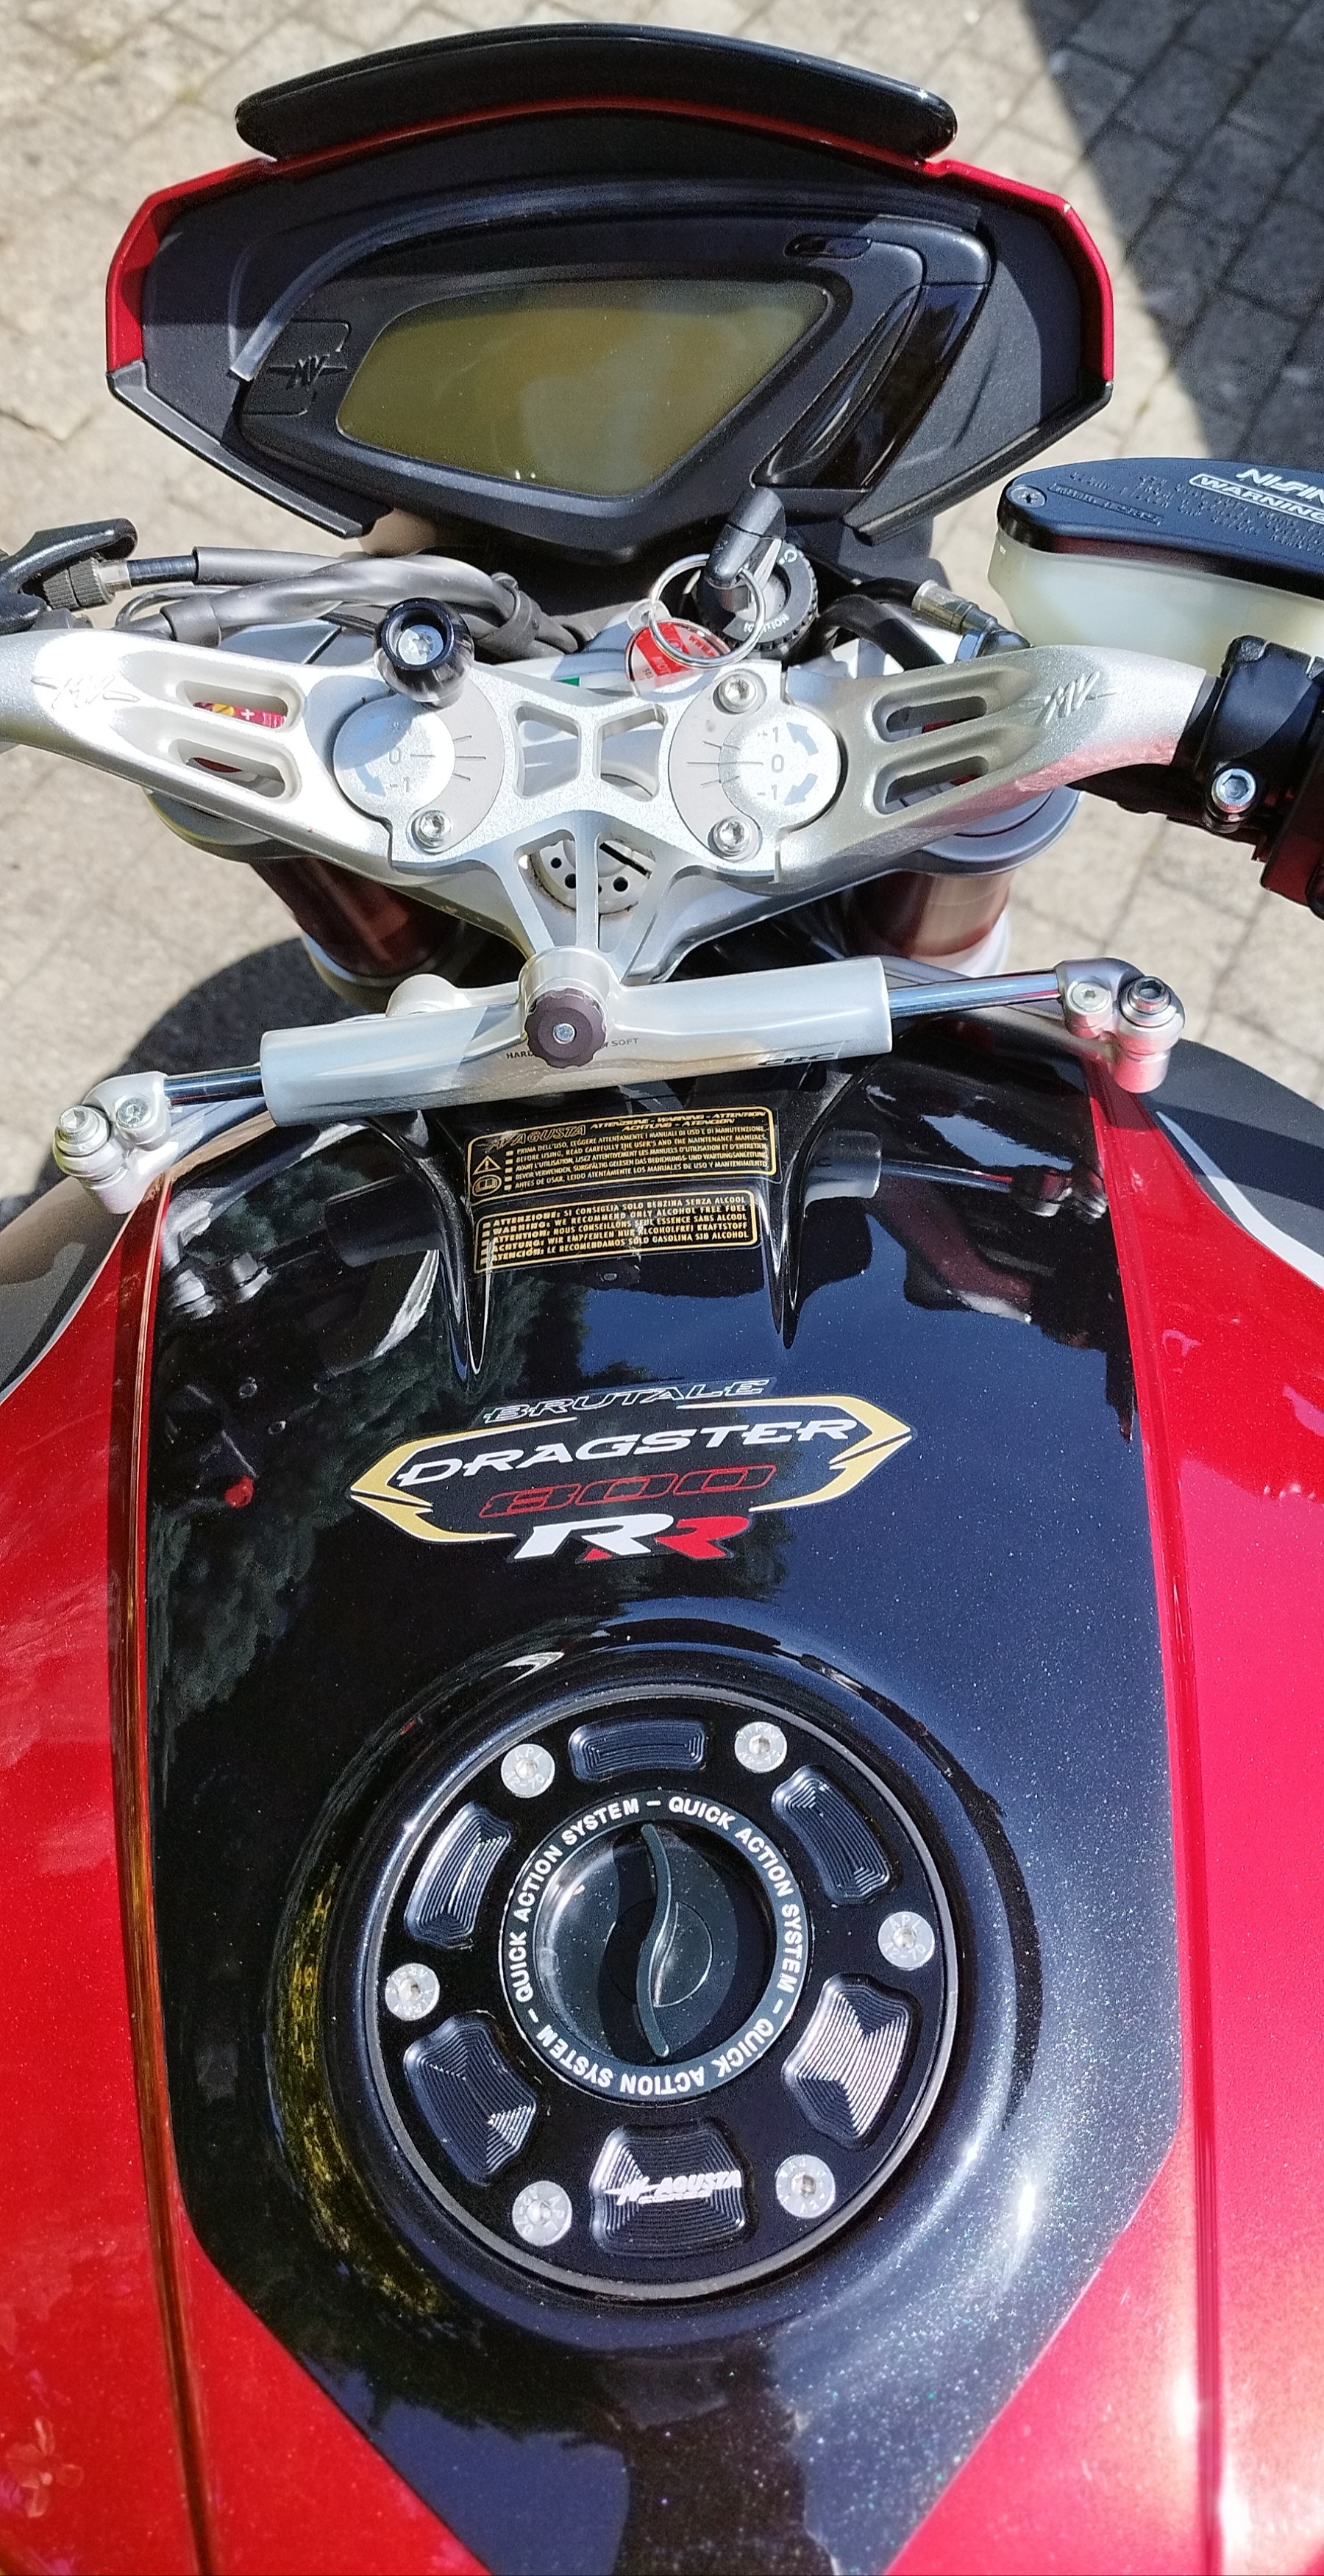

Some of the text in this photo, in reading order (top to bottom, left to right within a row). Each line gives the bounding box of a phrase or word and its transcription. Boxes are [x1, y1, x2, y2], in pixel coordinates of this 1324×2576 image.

[389, 746, 402, 766] 0
[771, 754, 785, 774] 0
[757, 784, 777, 801] -1
[611, 1038, 639, 1047] SOFT
[510, 1124, 586, 1146] AGUSTA
[516, 1145, 536, 1155] PRIMA
[598, 1132, 644, 1143] ATTENTAMENTE
[649, 1130, 677, 1139] MANUALI
[686, 1128, 700, 1136] USO
[516, 1153, 539, 1163] BEFORE
[566, 1147, 583, 1156] READ
[584, 1143, 619, 1154] CAREFULLY
[621, 1142, 633, 1150] THE
[658, 1138, 672, 1146] AND
[687, 1135, 733, 1144] MAINTENANCE
[515, 1162, 533, 1171] AVANT
[591, 1150, 637, 1162] ATTENTIVEMENT
[649, 1147, 677, 1156] MANUELS
[515, 1171, 533, 1180] BEVOR
[608, 1159, 633, 1169] GELESEN
[635, 1157, 647, 1166] DAS
[515, 1180, 534, 1189] ANTES
[535, 1178, 544, 1186] DE
[566, 1172, 586, 1182] LEIDO
[633, 1166, 646, 1174] LOS
[647, 1163, 681, 1173] MANUALES
[693, 1162, 707, 1170] USO
[492, 1220, 550, 1235] WARNING:
[554, 1219, 566, 1227] WE
[571, 1212, 626, 1224] RECOMMEND
[630, 1210, 652, 1219] ONLY
[656, 1207, 695, 1216] ALCOHOL
[700, 1205, 721, 1213] FREE
[493, 1210, 560, 1227] ATTENZIONE:
[575, 1205, 619, 1216] CONSIGLIA
[622, 1202, 644, 1211] SOLO
[647, 1199, 683, 1209] BENZINA
[685, 1198, 711, 1206] SENZA
[714, 1196, 746, 1205] ALCOOL
[491, 1221, 747, 1252] ACHTUNG: WIR EMPFEHLEN NUR ALCOHOLFREI KRAFTSTOFF
[493, 1228, 550, 1244] ATTENTION:
[553, 1225, 575, 1235] NOUS
[578, 1219, 631, 1232] CONSEILLONS
[656, 1216, 690, 1224] ESSENCE
[716, 1213, 747, 1221] ALCOOL
[547, 1246, 556, 1254] LE
[559, 1238, 624, 1252] RECOMENDAMOS
[652, 1233, 692, 1243] GASOLINA
[711, 1231, 749, 1239] ALCOHOL
[484, 1379, 770, 1424] BRUTALE
[396, 1419, 858, 1487] DRAGSTER
[479, 1464, 777, 1518] 800
[513, 1513, 751, 1561] RR
[561, 1797, 640, 1847] SYSTEM
[513, 1844, 563, 1923] ACTION
[669, 1796, 736, 1831] QUICK
[736, 1828, 794, 1897] ACTION
[777, 1903, 805, 1993] SYSTEM
[509, 1931, 534, 2003] QUICK
[536, 2024, 613, 2088] SYSTEM
[711, 2017, 775, 2078] QUICK
[619, 2066, 705, 2096] ACTION
[654, 2170, 741, 2195] AGUSTA
